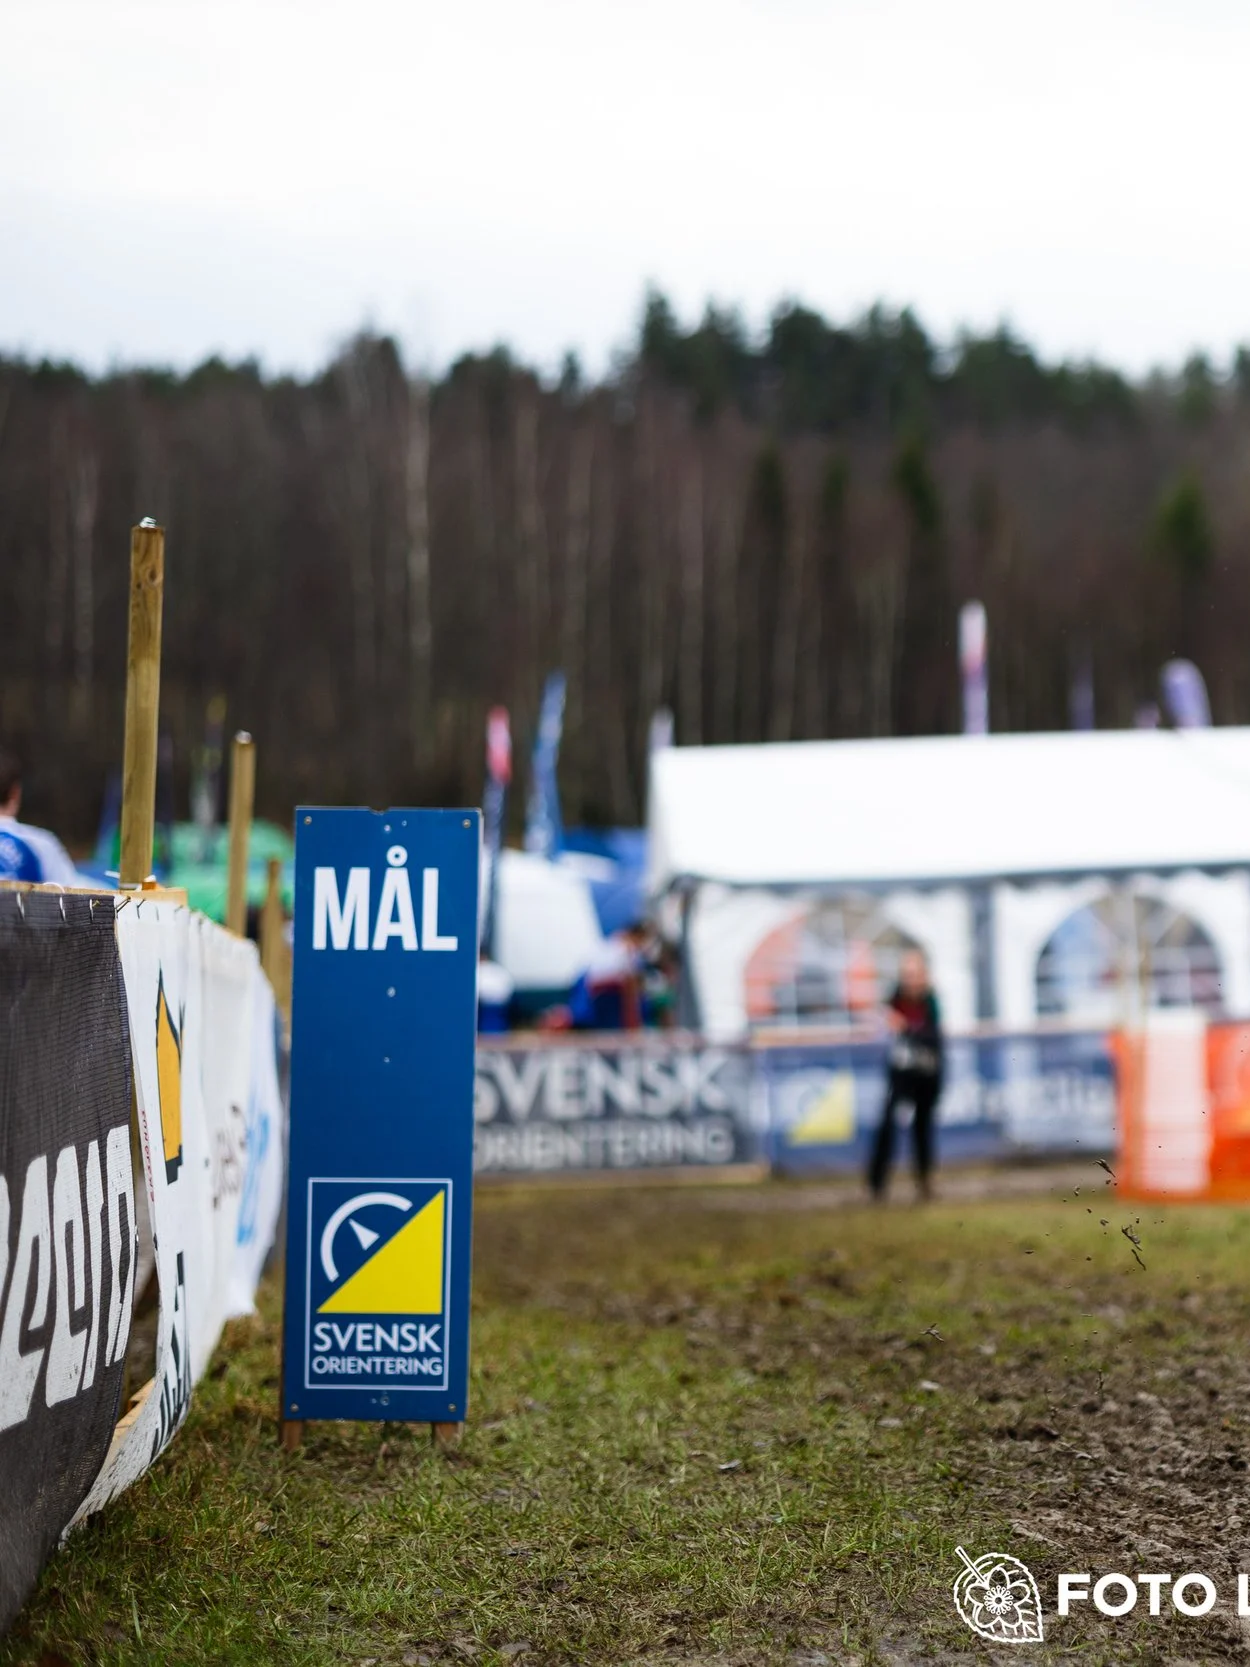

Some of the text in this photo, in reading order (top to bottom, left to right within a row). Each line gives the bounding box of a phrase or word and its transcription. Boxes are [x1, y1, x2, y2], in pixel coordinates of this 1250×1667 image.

[312, 845, 459, 951] MÅL
[0, 1124, 138, 1432] eera
[312, 1355, 443, 1376] ORIENTERING
[313, 1322, 442, 1353] SVENSK
